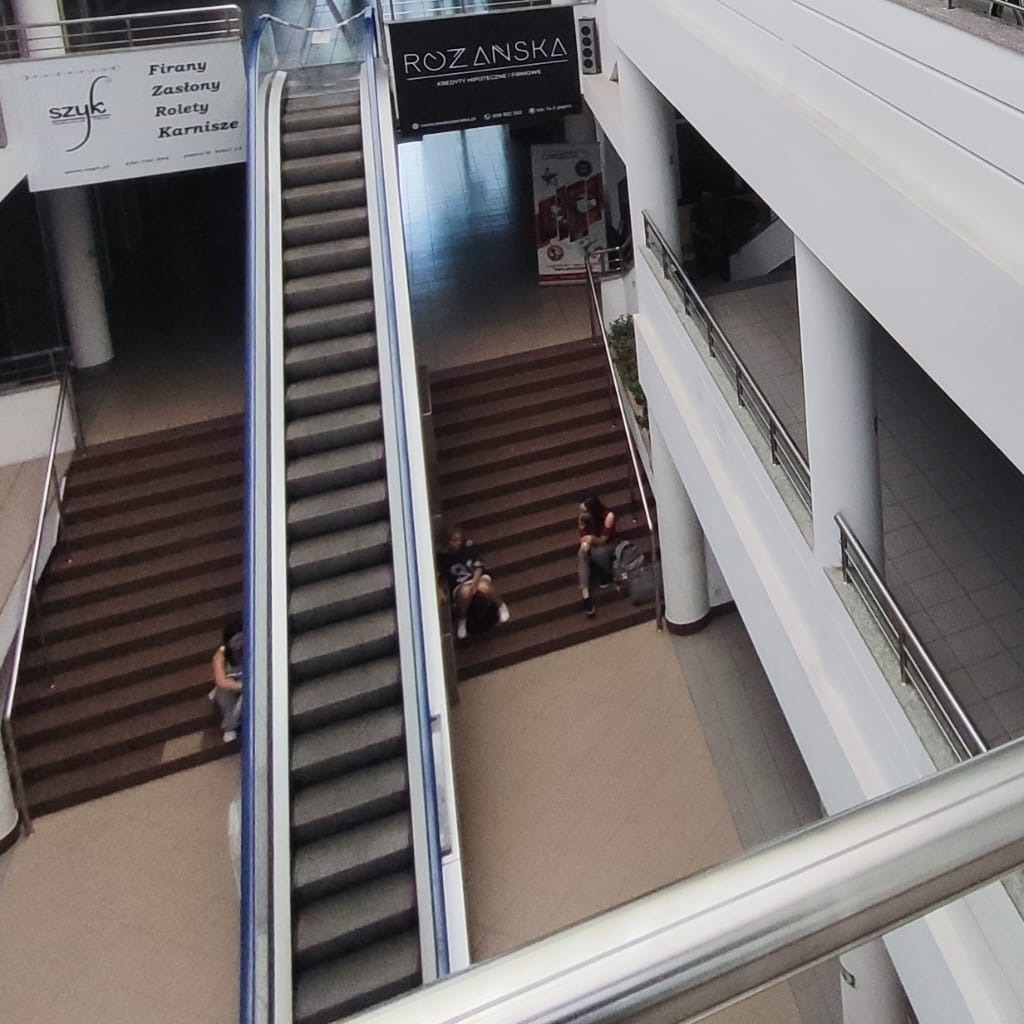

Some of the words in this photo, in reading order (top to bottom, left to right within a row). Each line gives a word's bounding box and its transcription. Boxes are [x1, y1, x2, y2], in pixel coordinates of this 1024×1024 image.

[149, 61, 206, 76] Firany
[151, 80, 221, 97] Zasłony
[49, 75, 107, 153] szyk
[154, 102, 209, 118] Rolety
[157, 119, 239, 139] Karnisze
